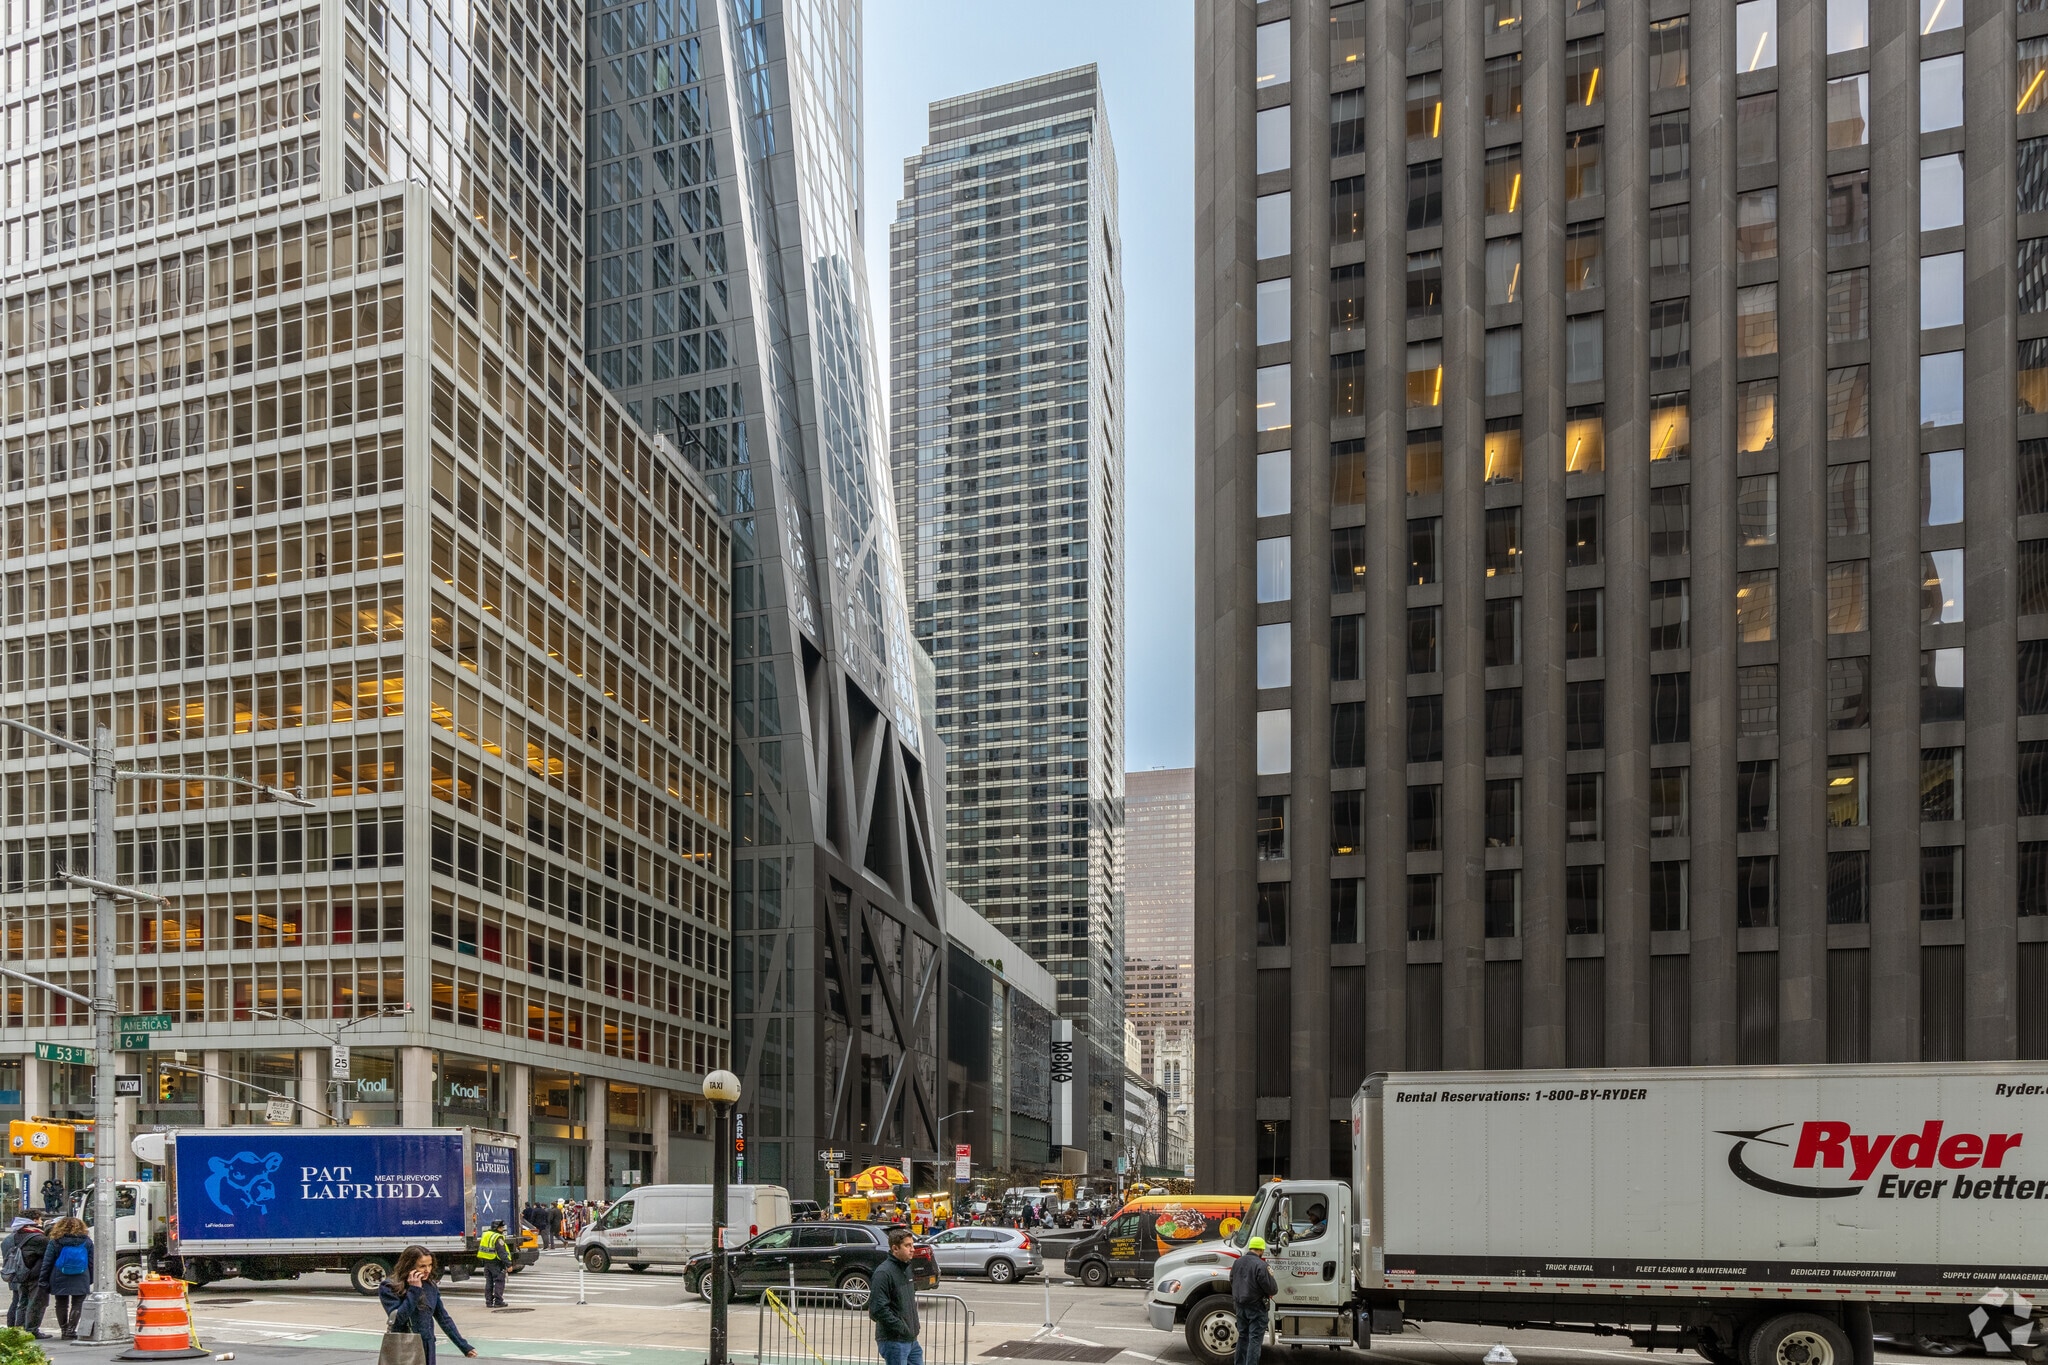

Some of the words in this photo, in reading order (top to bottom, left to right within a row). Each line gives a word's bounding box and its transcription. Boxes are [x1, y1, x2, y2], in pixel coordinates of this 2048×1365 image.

[123, 1020, 168, 1031] AMERICAS
[125, 1035, 133, 1048] 6
[39, 1044, 49, 1059] W
[56, 1047, 72, 1061] 53
[75, 1048, 83, 1057] ST
[334, 1058, 348, 1068] 25
[119, 1081, 136, 1090] WAY
[357, 1078, 387, 1092] Knoll
[451, 1082, 479, 1099] Knoll
[709, 1081, 723, 1090] TAXI
[1396, 1091, 1438, 1103] Rental
[1441, 1090, 1530, 1102] Reservations:
[1535, 1089, 1648, 1101] 1-800-BY-RYDER
[736, 1113, 744, 1139] PARK
[475, 1151, 489, 1162] PAT
[1793, 1120, 2024, 1181] Ryder
[300, 1166, 352, 1182] PAT
[374, 1174, 396, 1182] MEAT
[476, 1162, 510, 1174] LAFRIEDA
[300, 1183, 443, 1200] LAFRIEDA
[1877, 1174, 1948, 1199] Ever
[1545, 1263, 1567, 1271] TRUCK
[1657, 1266, 1688, 1274] LEASING
[1689, 1266, 1695, 1274] &
[1696, 1266, 1748, 1275] MAINTENANCE
[1790, 1268, 1831, 1277] DEDICATED
[1832, 1269, 1897, 1278] TRANSPORTATION
[1942, 1271, 1972, 1280] SUPPLY
[1972, 1272, 1997, 1280] CHAIN
